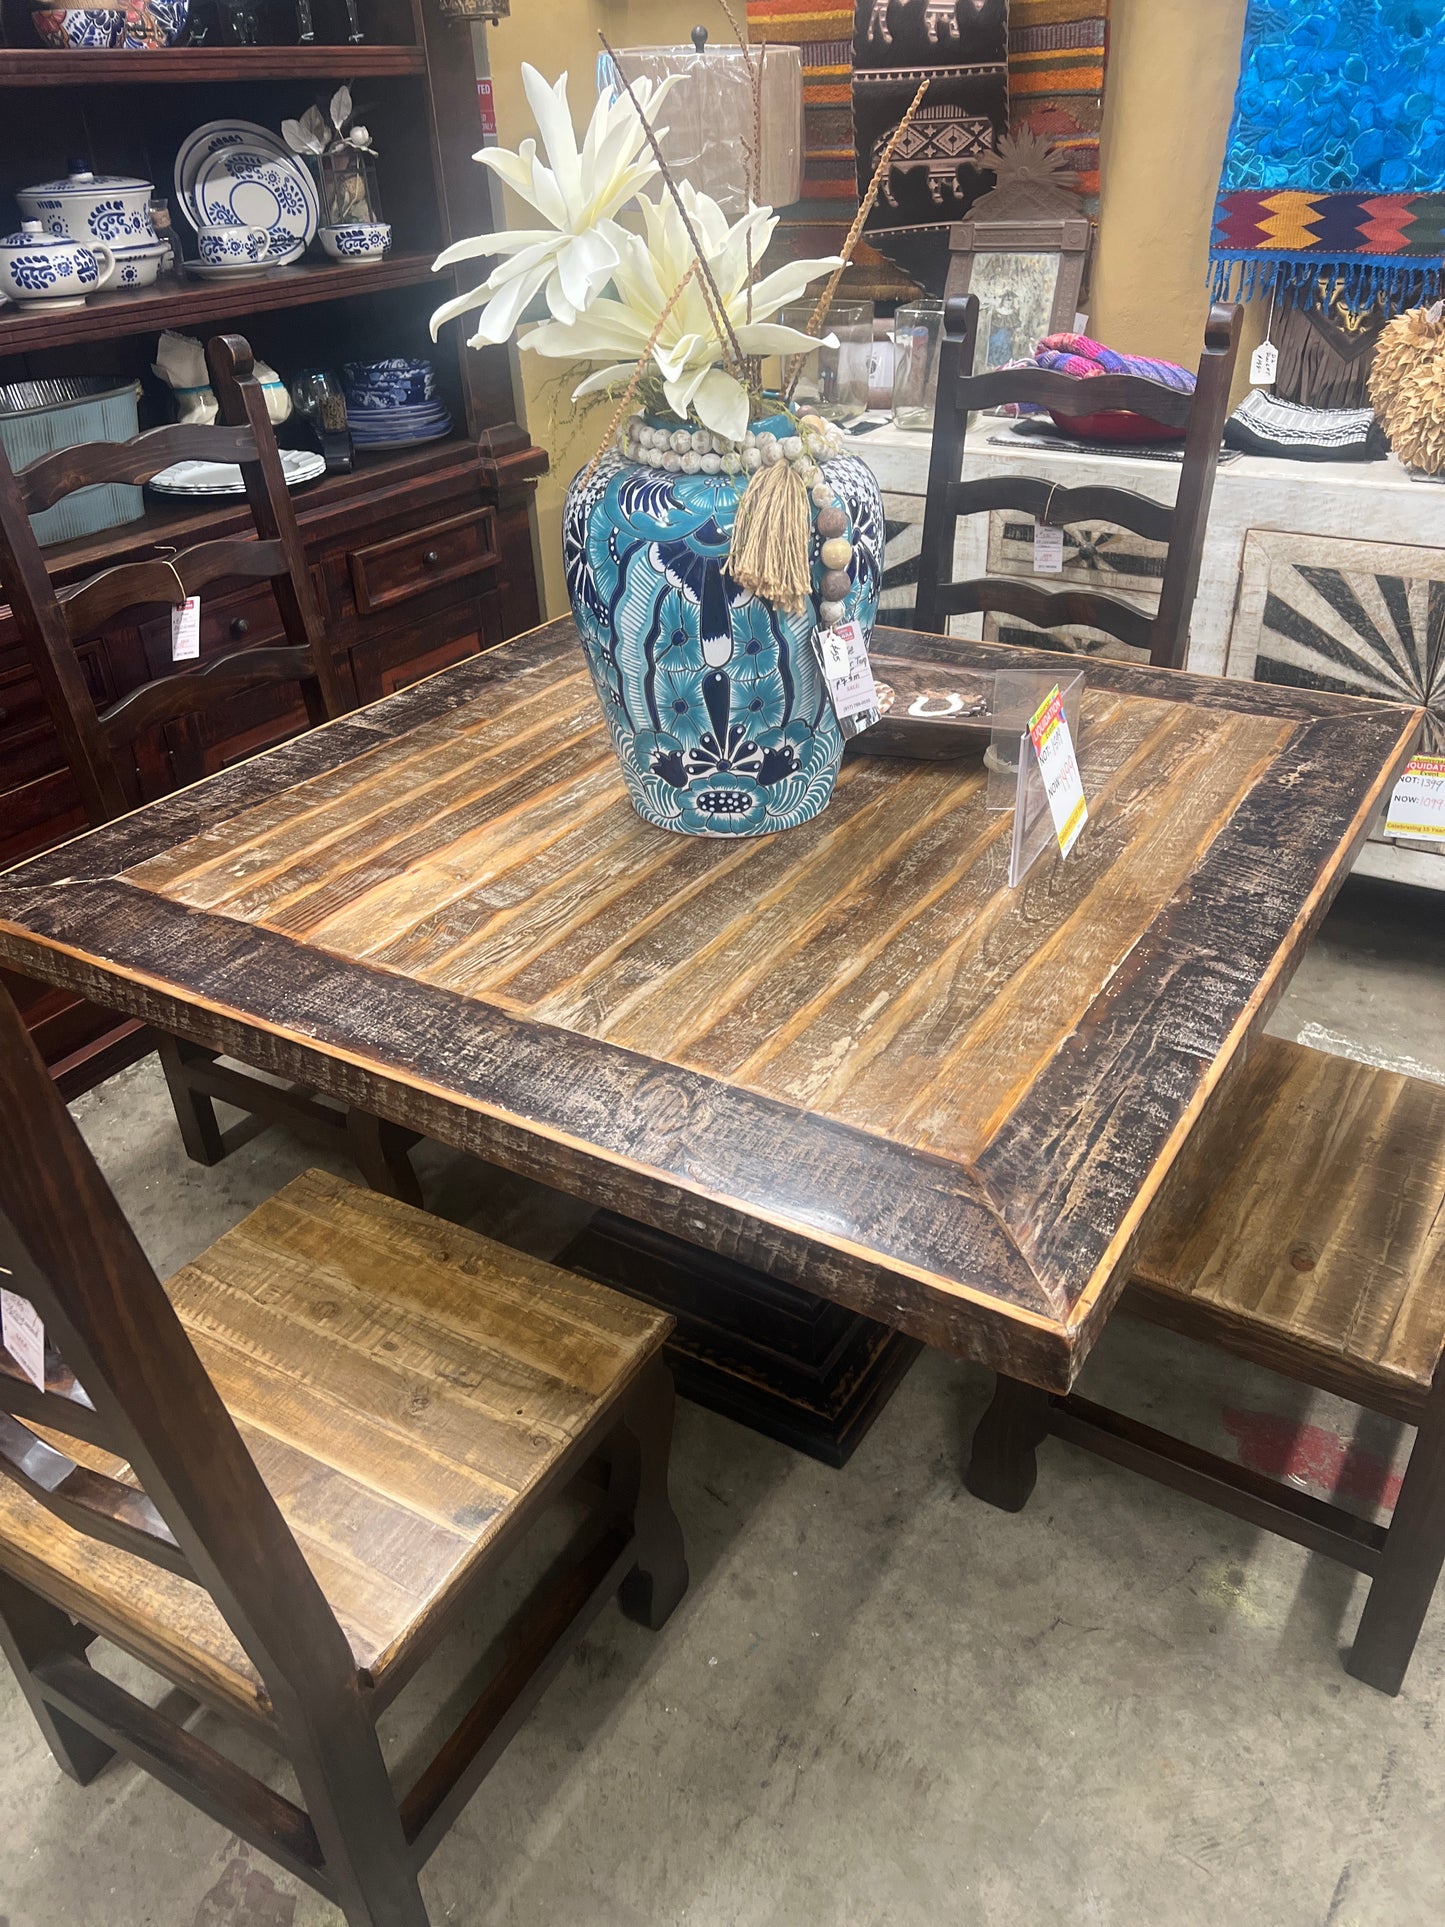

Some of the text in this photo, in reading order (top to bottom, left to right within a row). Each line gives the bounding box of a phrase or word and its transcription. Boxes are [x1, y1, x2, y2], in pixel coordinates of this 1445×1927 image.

[1033, 700, 1061, 741] LIQUIDATION
[1407, 762, 1445, 771] IQUIDATI
[1394, 795, 1419, 804] NOW:
